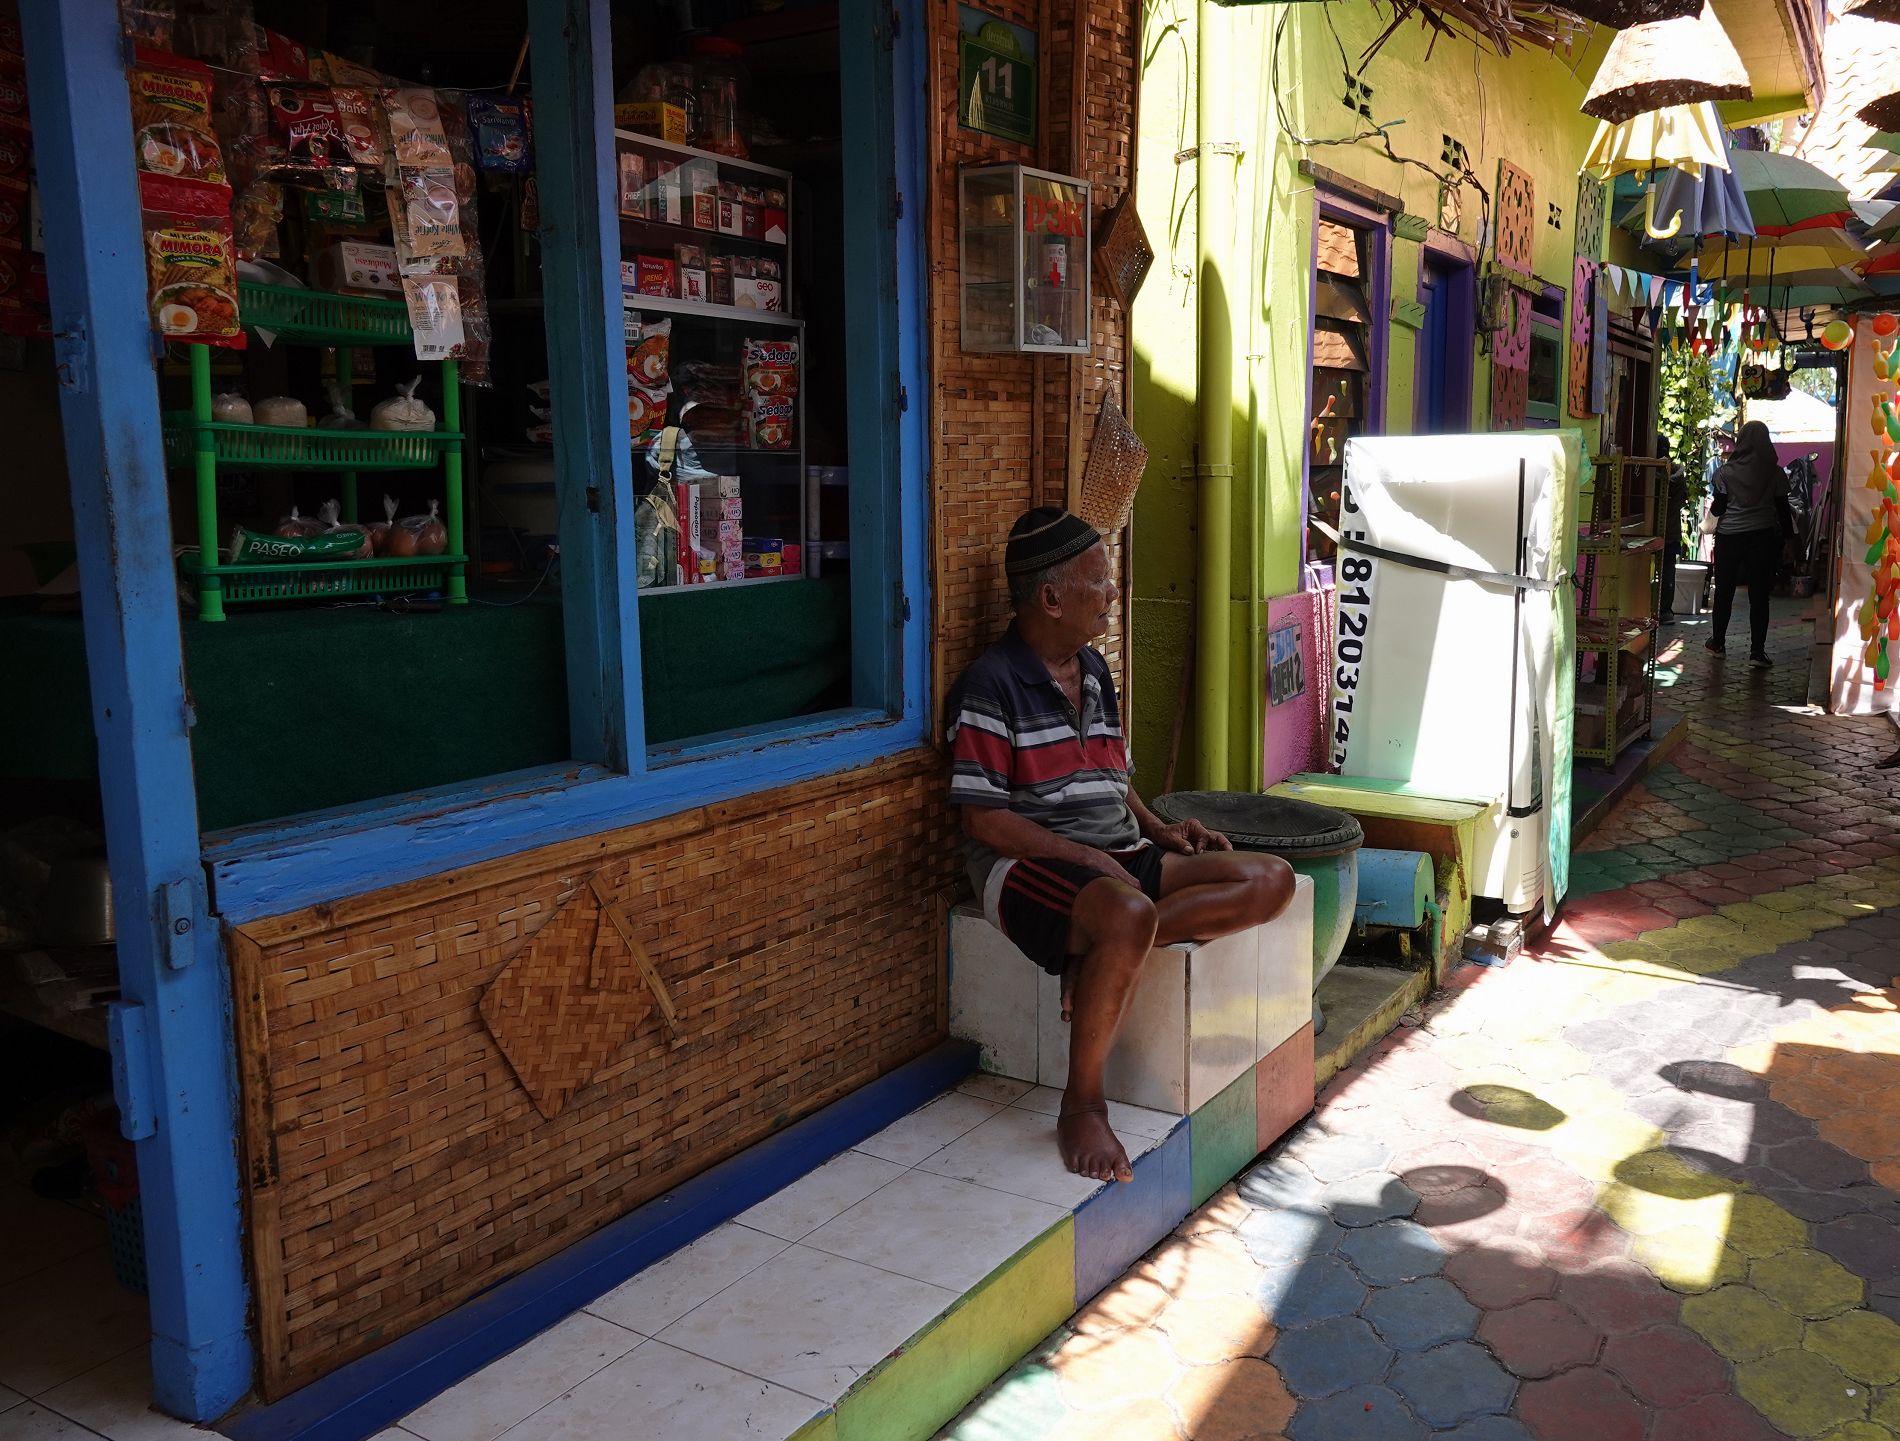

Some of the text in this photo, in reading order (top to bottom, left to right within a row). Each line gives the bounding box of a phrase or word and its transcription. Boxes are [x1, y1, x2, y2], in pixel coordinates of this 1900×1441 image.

[982, 56, 1013, 99] 11
[142, 80, 206, 103] MIMORA
[624, 190, 641, 201] CHIEF
[1023, 194, 1085, 238] P3K
[160, 239, 223, 257] MIMORA
[748, 349, 797, 363] Sedaap
[249, 542, 302, 557] PASEO
